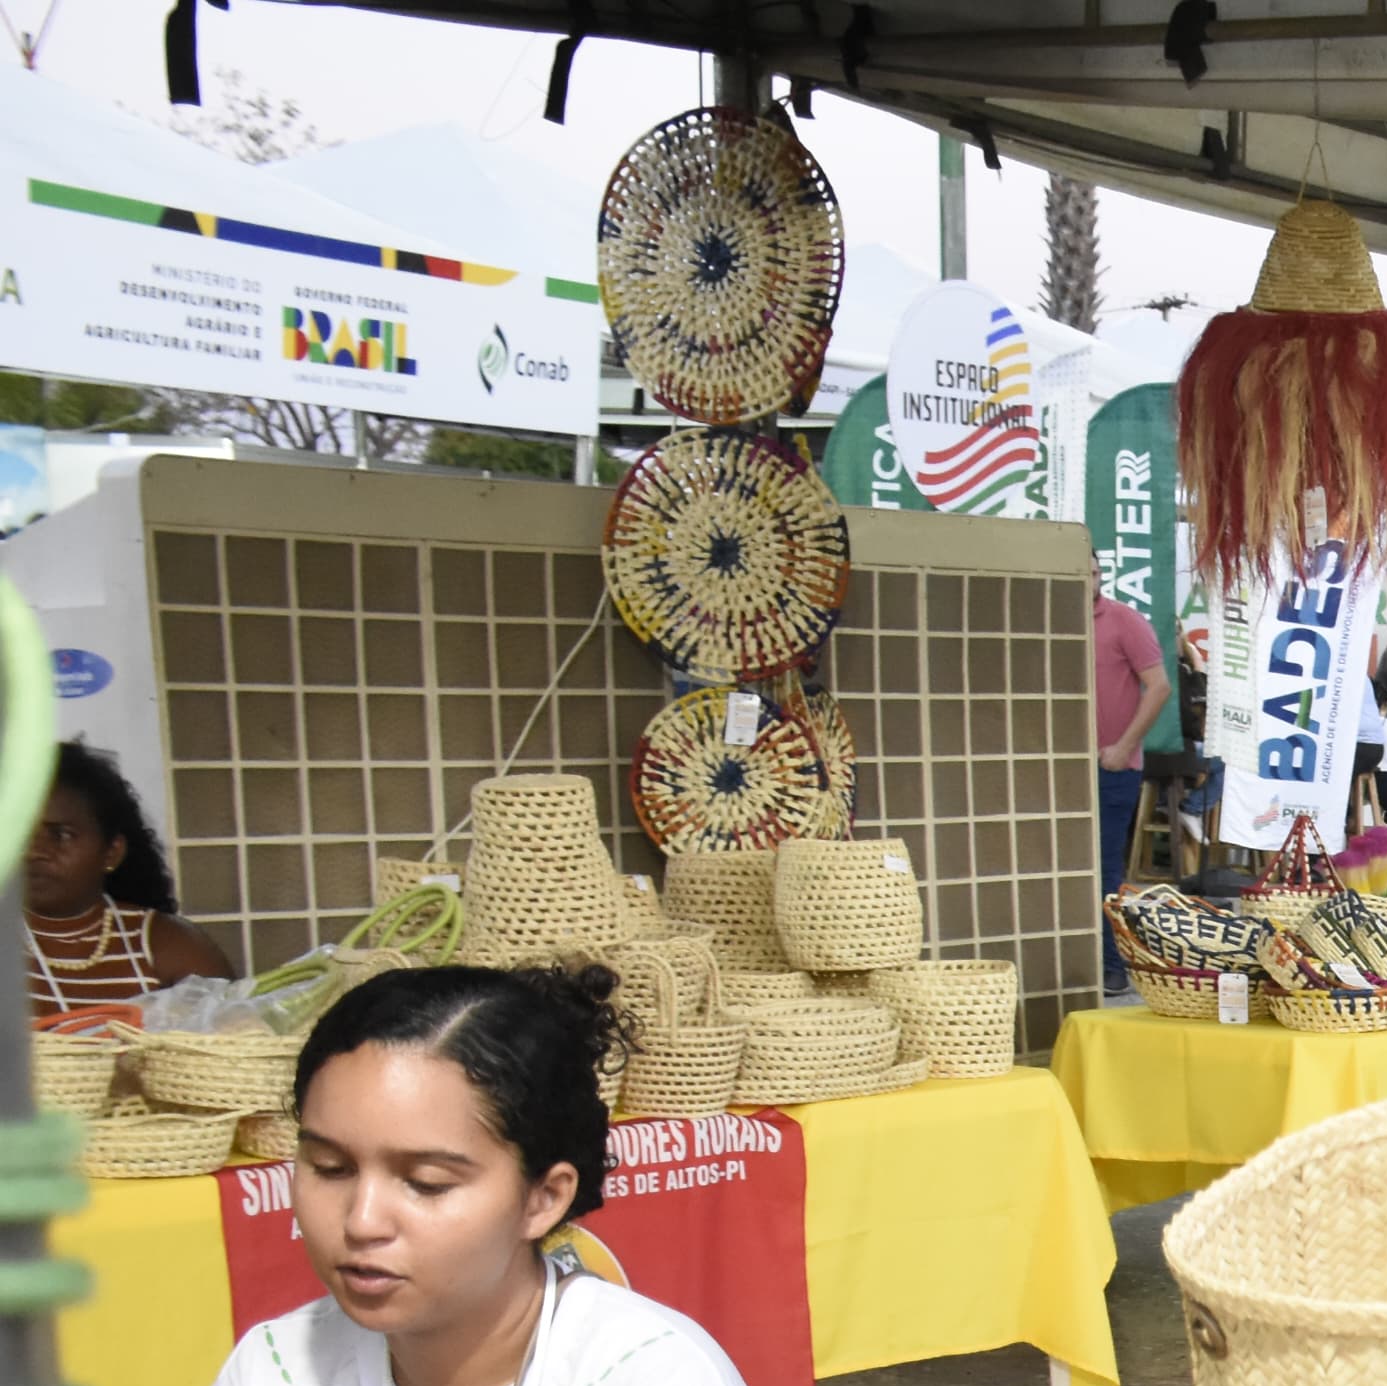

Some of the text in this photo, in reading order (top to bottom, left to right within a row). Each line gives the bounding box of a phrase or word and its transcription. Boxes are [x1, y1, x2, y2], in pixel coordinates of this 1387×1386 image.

[119, 280, 261, 315] DESENVOLVIMENTO
[294, 286, 409, 313] GOVERNO FEDERAL
[84, 323, 261, 361] AGRICULTURA FAMILIAR
[185, 315, 261, 338] AGRÁRIO E
[282, 306, 417, 376] BRASIL
[515, 352, 569, 382] Conab
[935, 359, 999, 395] ESPAÇO
[903, 393, 1028, 431] INSTITUCIONAL
[1259, 540, 1349, 783] BADES
[1328, 676, 1343, 723] FOMENTO
[691, 1114, 782, 1158] RURAIS
[634, 1172, 660, 1195] DE
[666, 1160, 746, 1191] ALTOS-PI
